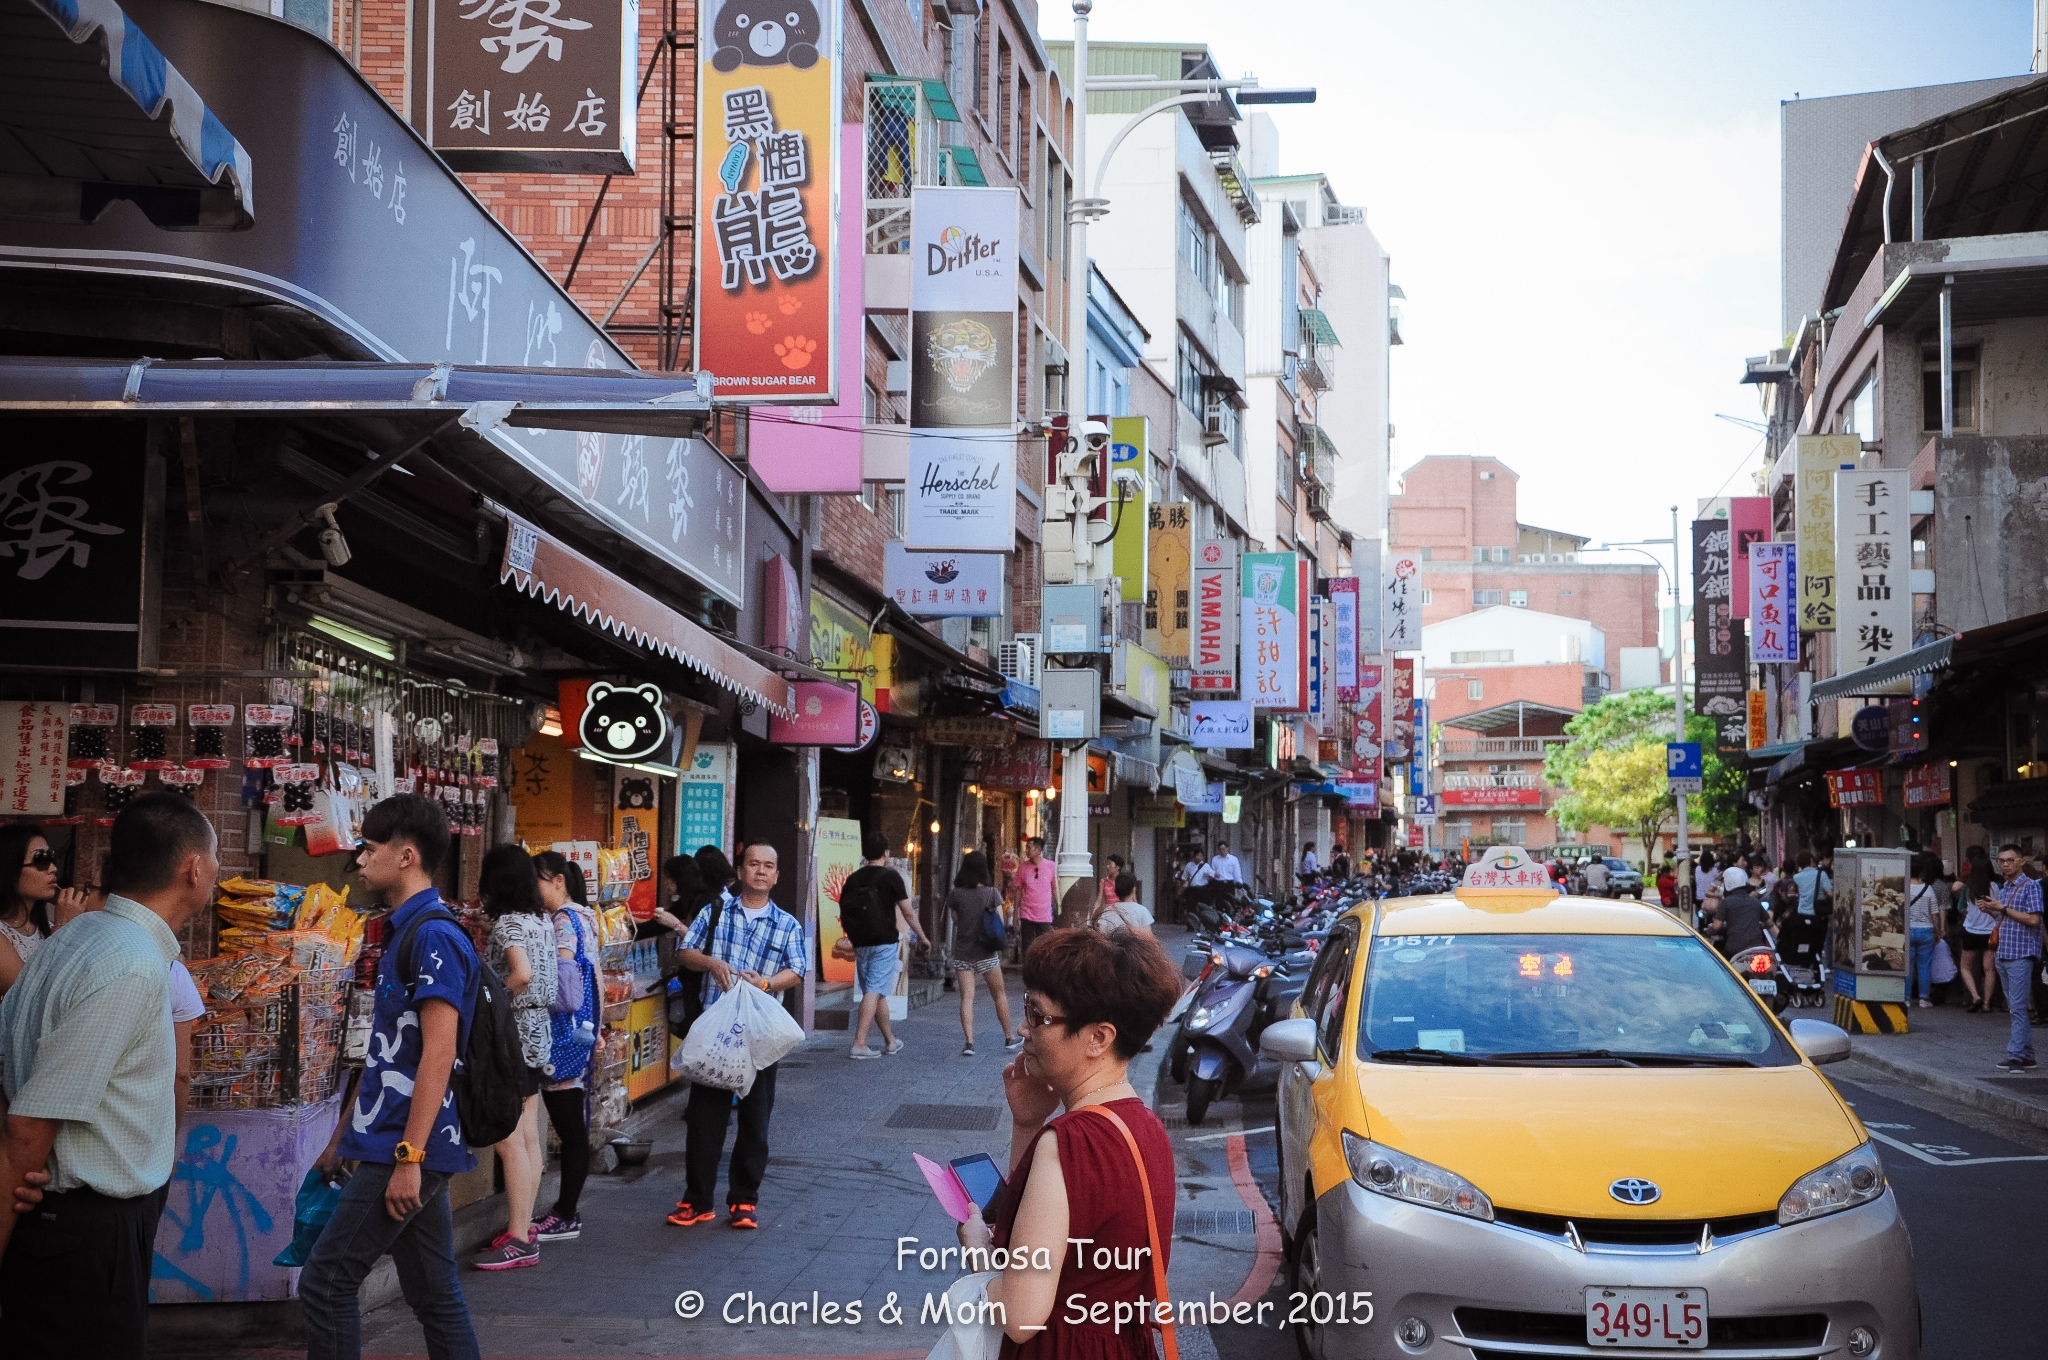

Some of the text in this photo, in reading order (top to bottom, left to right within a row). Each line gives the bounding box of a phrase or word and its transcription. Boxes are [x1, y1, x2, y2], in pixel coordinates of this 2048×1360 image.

[447, 87, 607, 137] 創始店
[333, 111, 406, 226] 創始店
[727, 150, 743, 180] TAIWAN
[715, 87, 814, 287] 黑糖熊
[927, 232, 1000, 276] Drifter
[975, 269, 1002, 277] U.S.A.
[712, 374, 816, 387] BROWN SUGAR BEAR
[920, 462, 1000, 498] Herschel
[1200, 572, 1222, 666] YAMAHA
[1757, 560, 1784, 651] 可口魚丸
[1803, 576, 1835, 626] 阿給
[1256, 607, 1282, 694] 許甜記
[1668, 748, 1687, 771] P
[1443, 775, 1536, 787] AMANDA CAFE
[1416, 797, 1429, 813] P
[1470, 869, 1546, 888] 台灣大車隊
[1379, 935, 1456, 946] 11577
[1592, 1301, 1703, 1340] 349-L5
